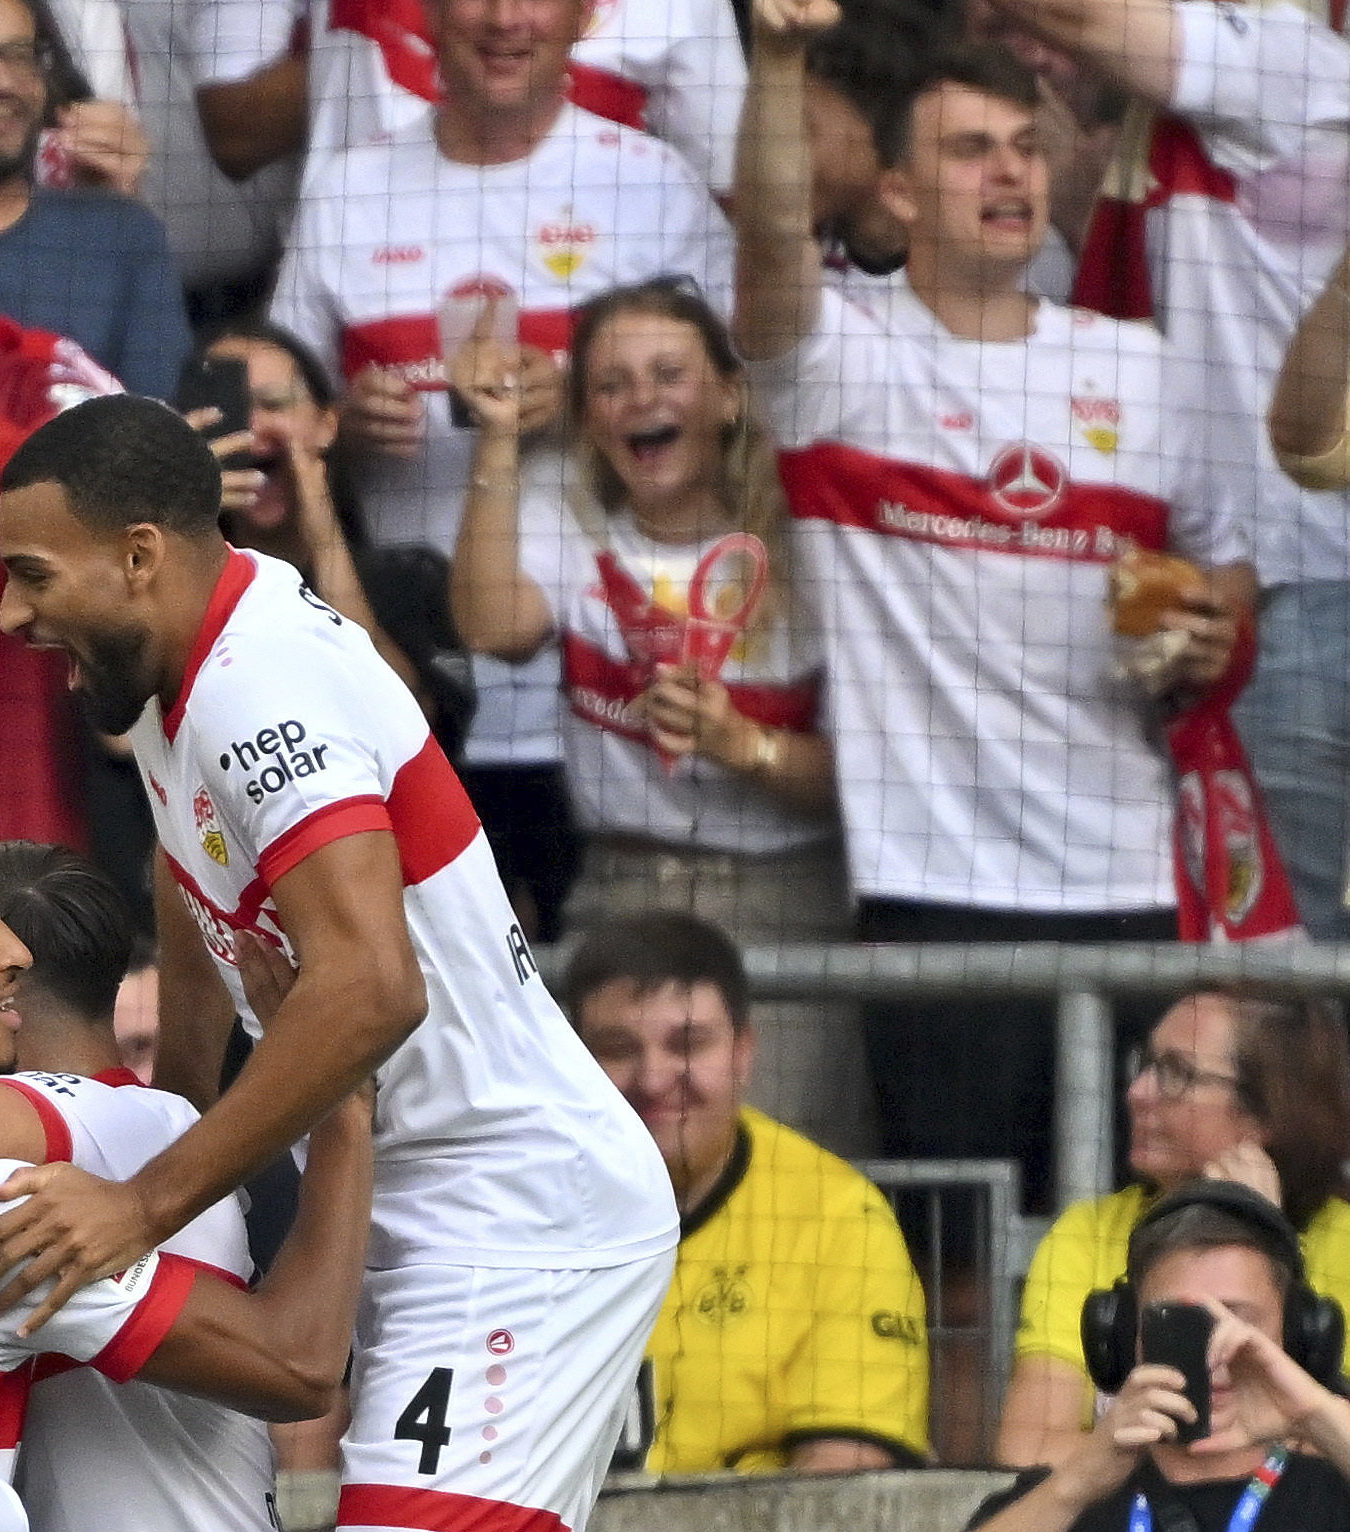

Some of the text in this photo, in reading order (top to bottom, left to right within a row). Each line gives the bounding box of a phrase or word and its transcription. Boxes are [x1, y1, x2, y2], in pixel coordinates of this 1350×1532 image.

[231, 719, 306, 772] hep
[246, 743, 329, 805] solar
[395, 1366, 454, 1475] 4
